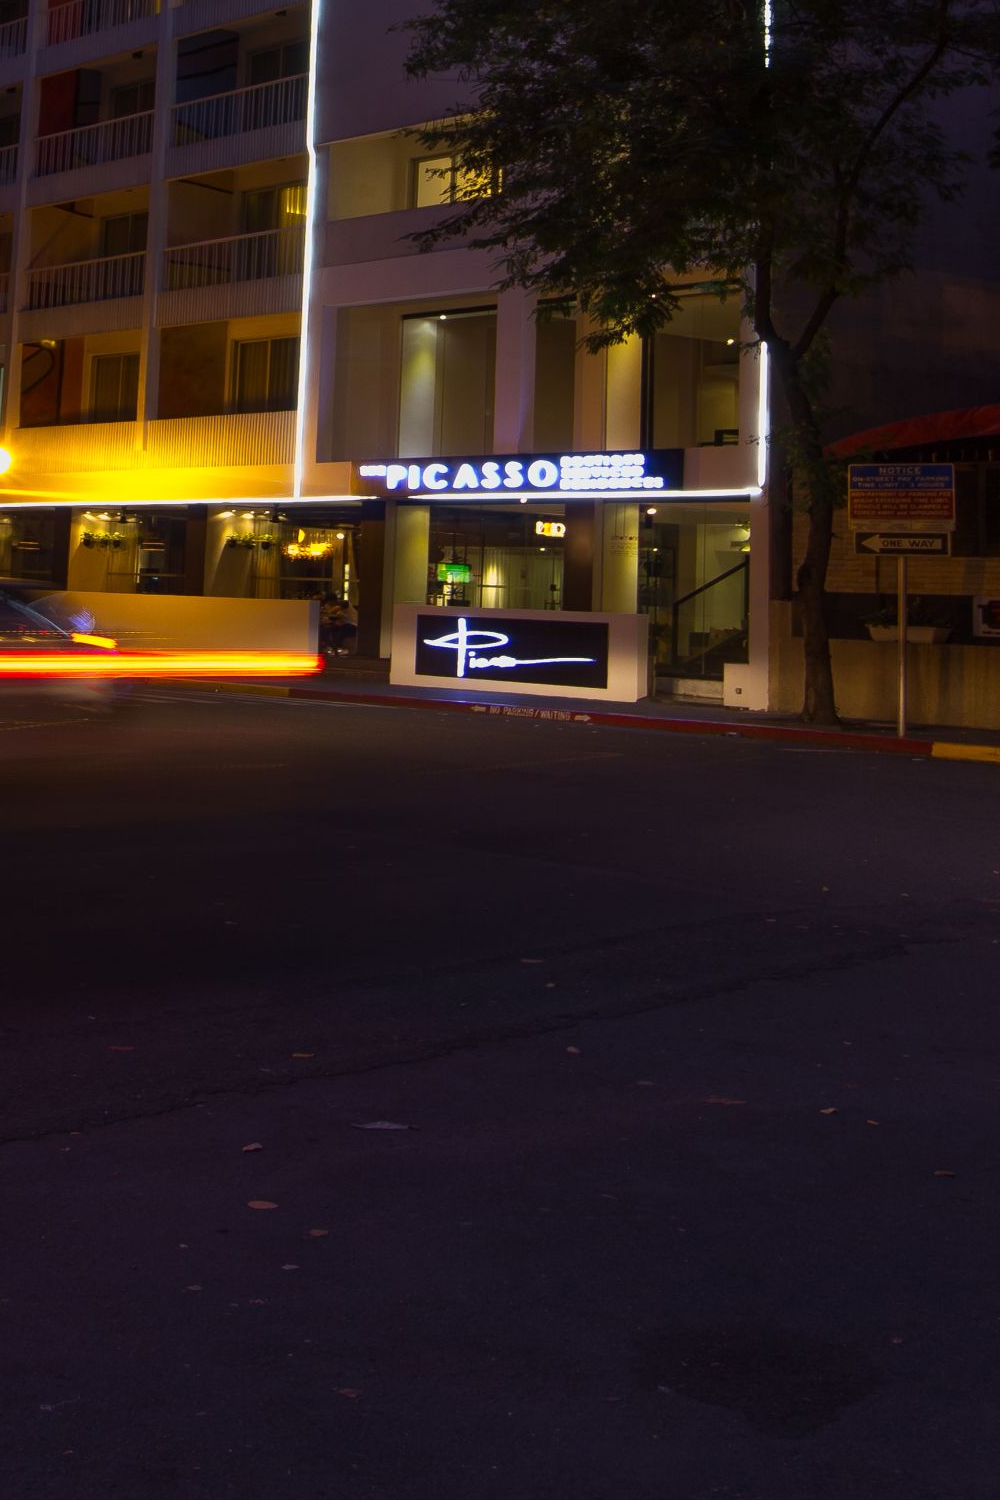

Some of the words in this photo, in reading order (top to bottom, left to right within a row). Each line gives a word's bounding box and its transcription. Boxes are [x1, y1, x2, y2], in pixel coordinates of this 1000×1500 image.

[386, 460, 559, 490] PICASSO
[879, 466, 921, 475] NOTICE
[882, 539, 903, 548] ONE
[907, 539, 935, 548] WAY
[489, 705, 501, 715] NO
